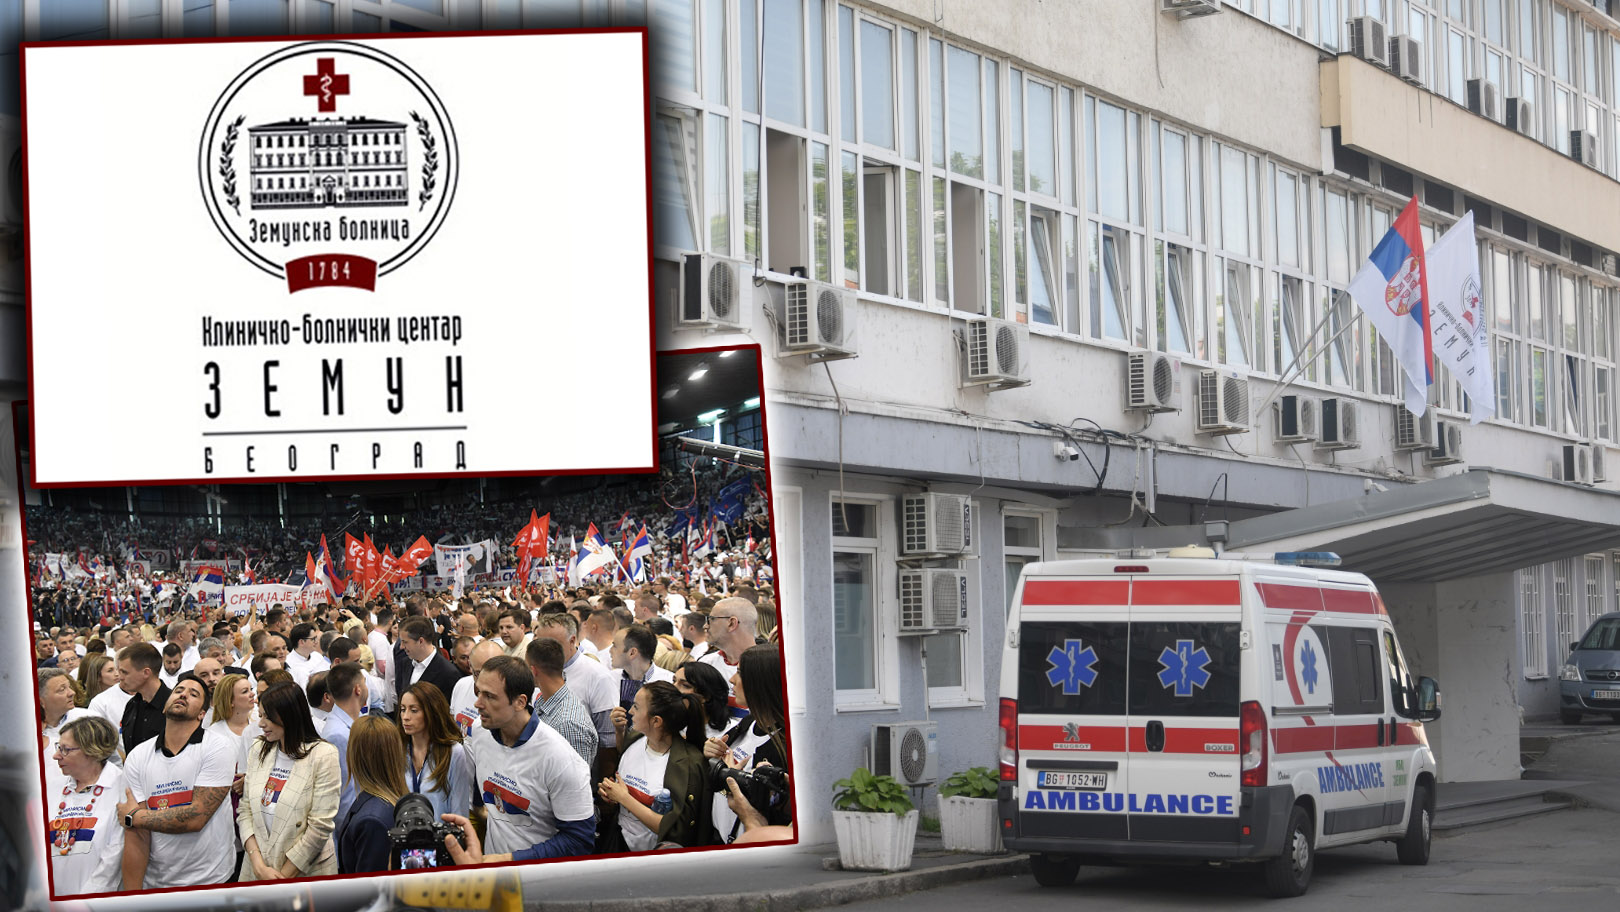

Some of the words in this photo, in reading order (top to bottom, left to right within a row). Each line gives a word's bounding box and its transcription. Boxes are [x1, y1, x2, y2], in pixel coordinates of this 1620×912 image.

[230, 592, 278, 605] СРБИЈА
[280, 591, 293, 602] ЈЕ
[1045, 773, 1058, 785] BG
[1317, 762, 1385, 793] AMBULANCE
[1025, 790, 1234, 815] AMBULANCE
